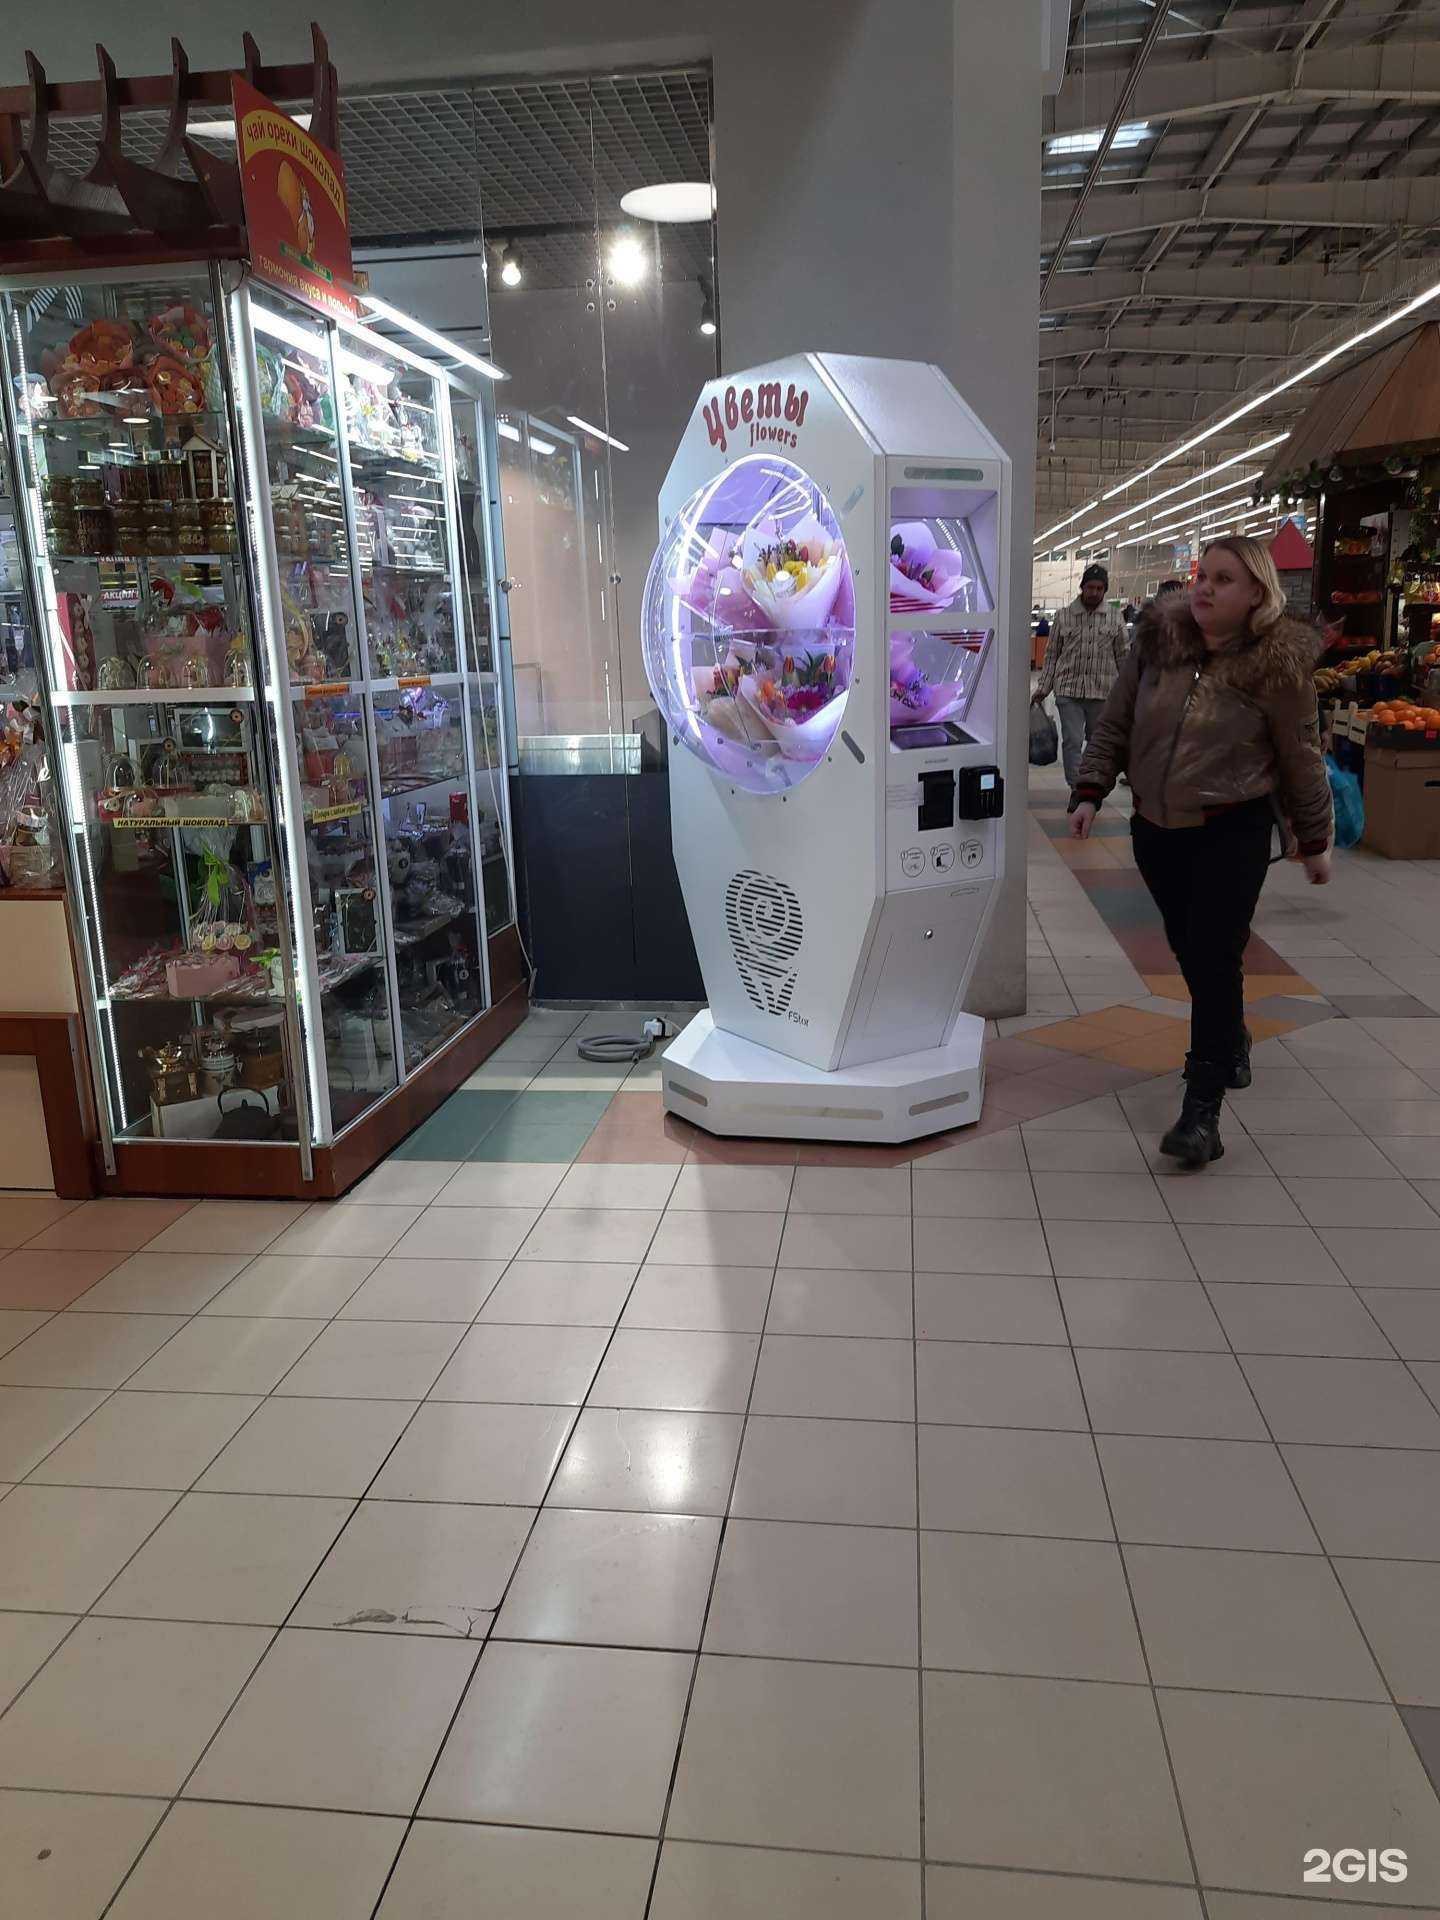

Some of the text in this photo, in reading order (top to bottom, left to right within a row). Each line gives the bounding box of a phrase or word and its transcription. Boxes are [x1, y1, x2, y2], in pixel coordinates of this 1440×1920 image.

[246, 115, 341, 207] чай орехи шоколад
[259, 255, 299, 288] гармония
[300, 277, 321, 300] вкуса
[749, 422, 798, 448] flowers
[117, 819, 226, 827] НАТУРАЛЬНЫЙ ШОКОЛАД
